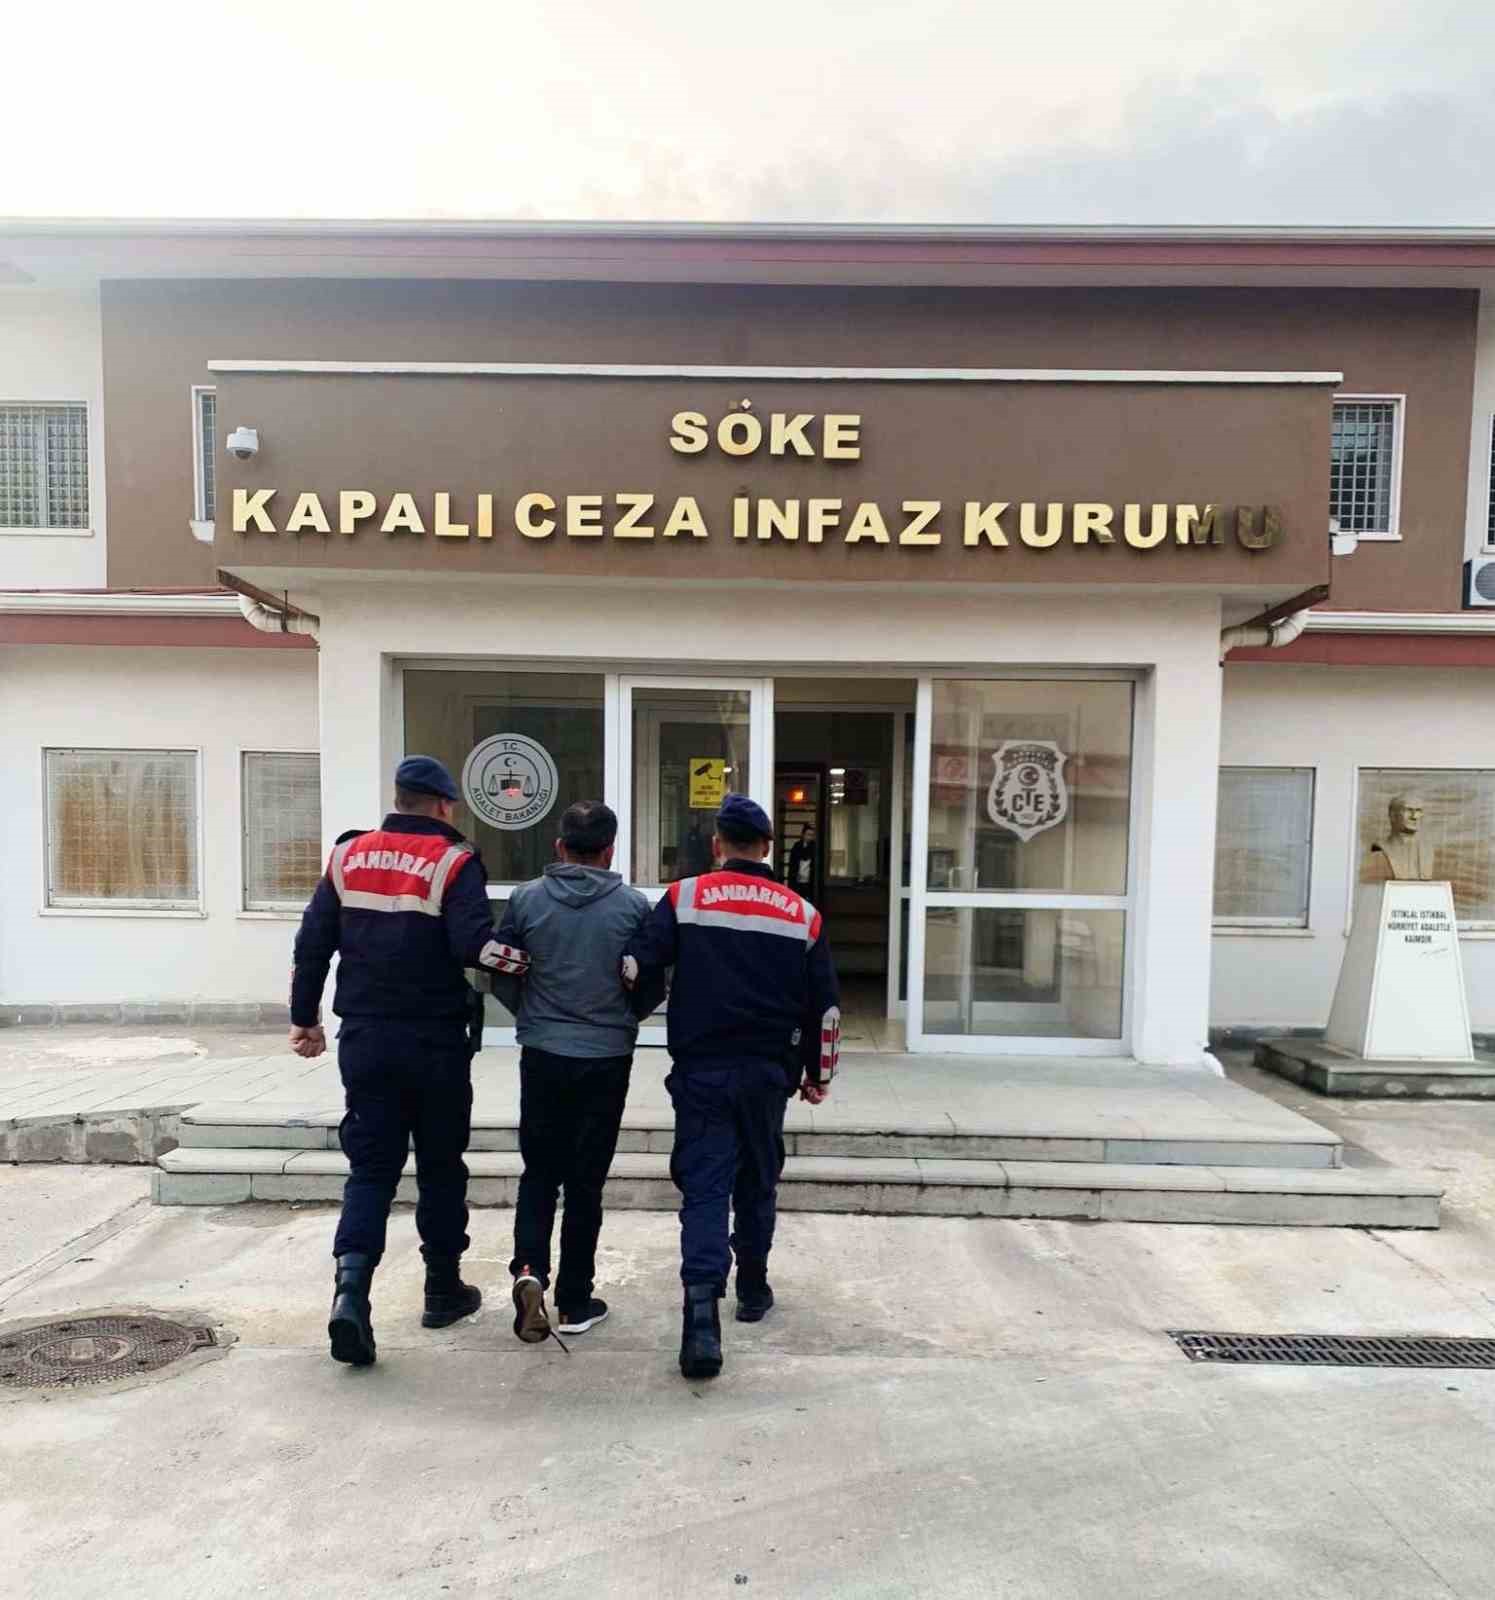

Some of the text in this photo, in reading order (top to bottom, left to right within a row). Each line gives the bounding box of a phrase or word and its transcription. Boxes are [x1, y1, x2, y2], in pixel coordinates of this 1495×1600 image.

[669, 398, 861, 460] SÖKE
[232, 487, 1281, 549] KAPALI CEZA İNFAZ KURUMU
[472, 787, 500, 819] ADALET
[701, 884, 800, 917] JANDARMA
